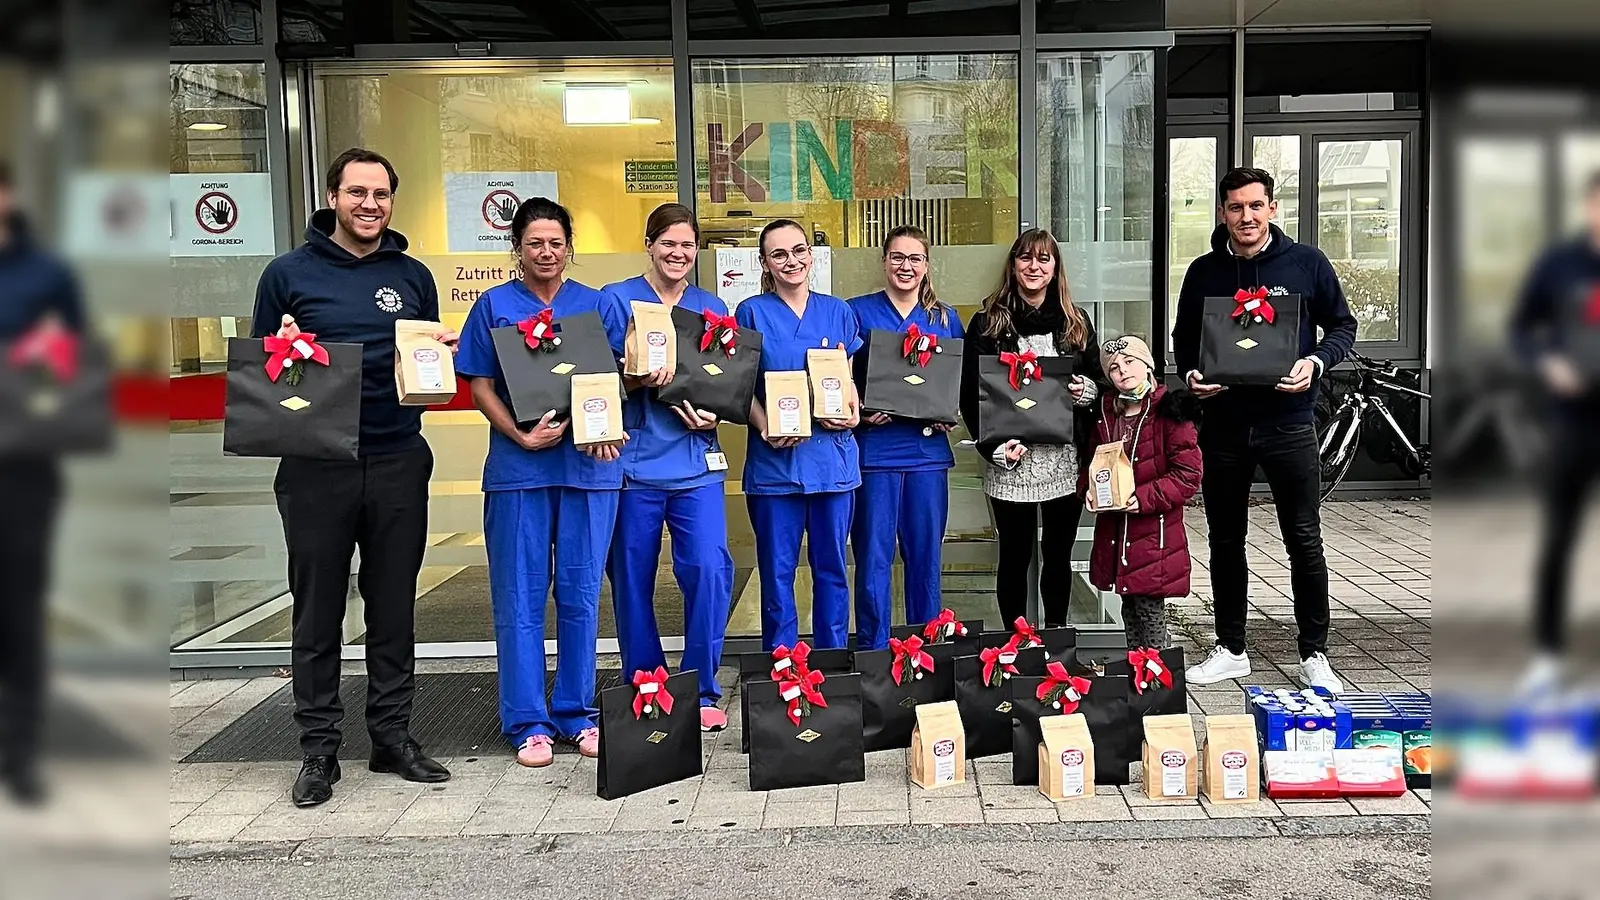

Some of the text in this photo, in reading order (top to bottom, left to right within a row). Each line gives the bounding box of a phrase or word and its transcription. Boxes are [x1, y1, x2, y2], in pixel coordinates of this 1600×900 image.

[638, 161, 660, 170] Kinder
[662, 161, 673, 170] mit
[707, 119, 1018, 203] KINDER
[456, 266, 525, 280] Zutritt nu
[451, 288, 484, 301] Rett
